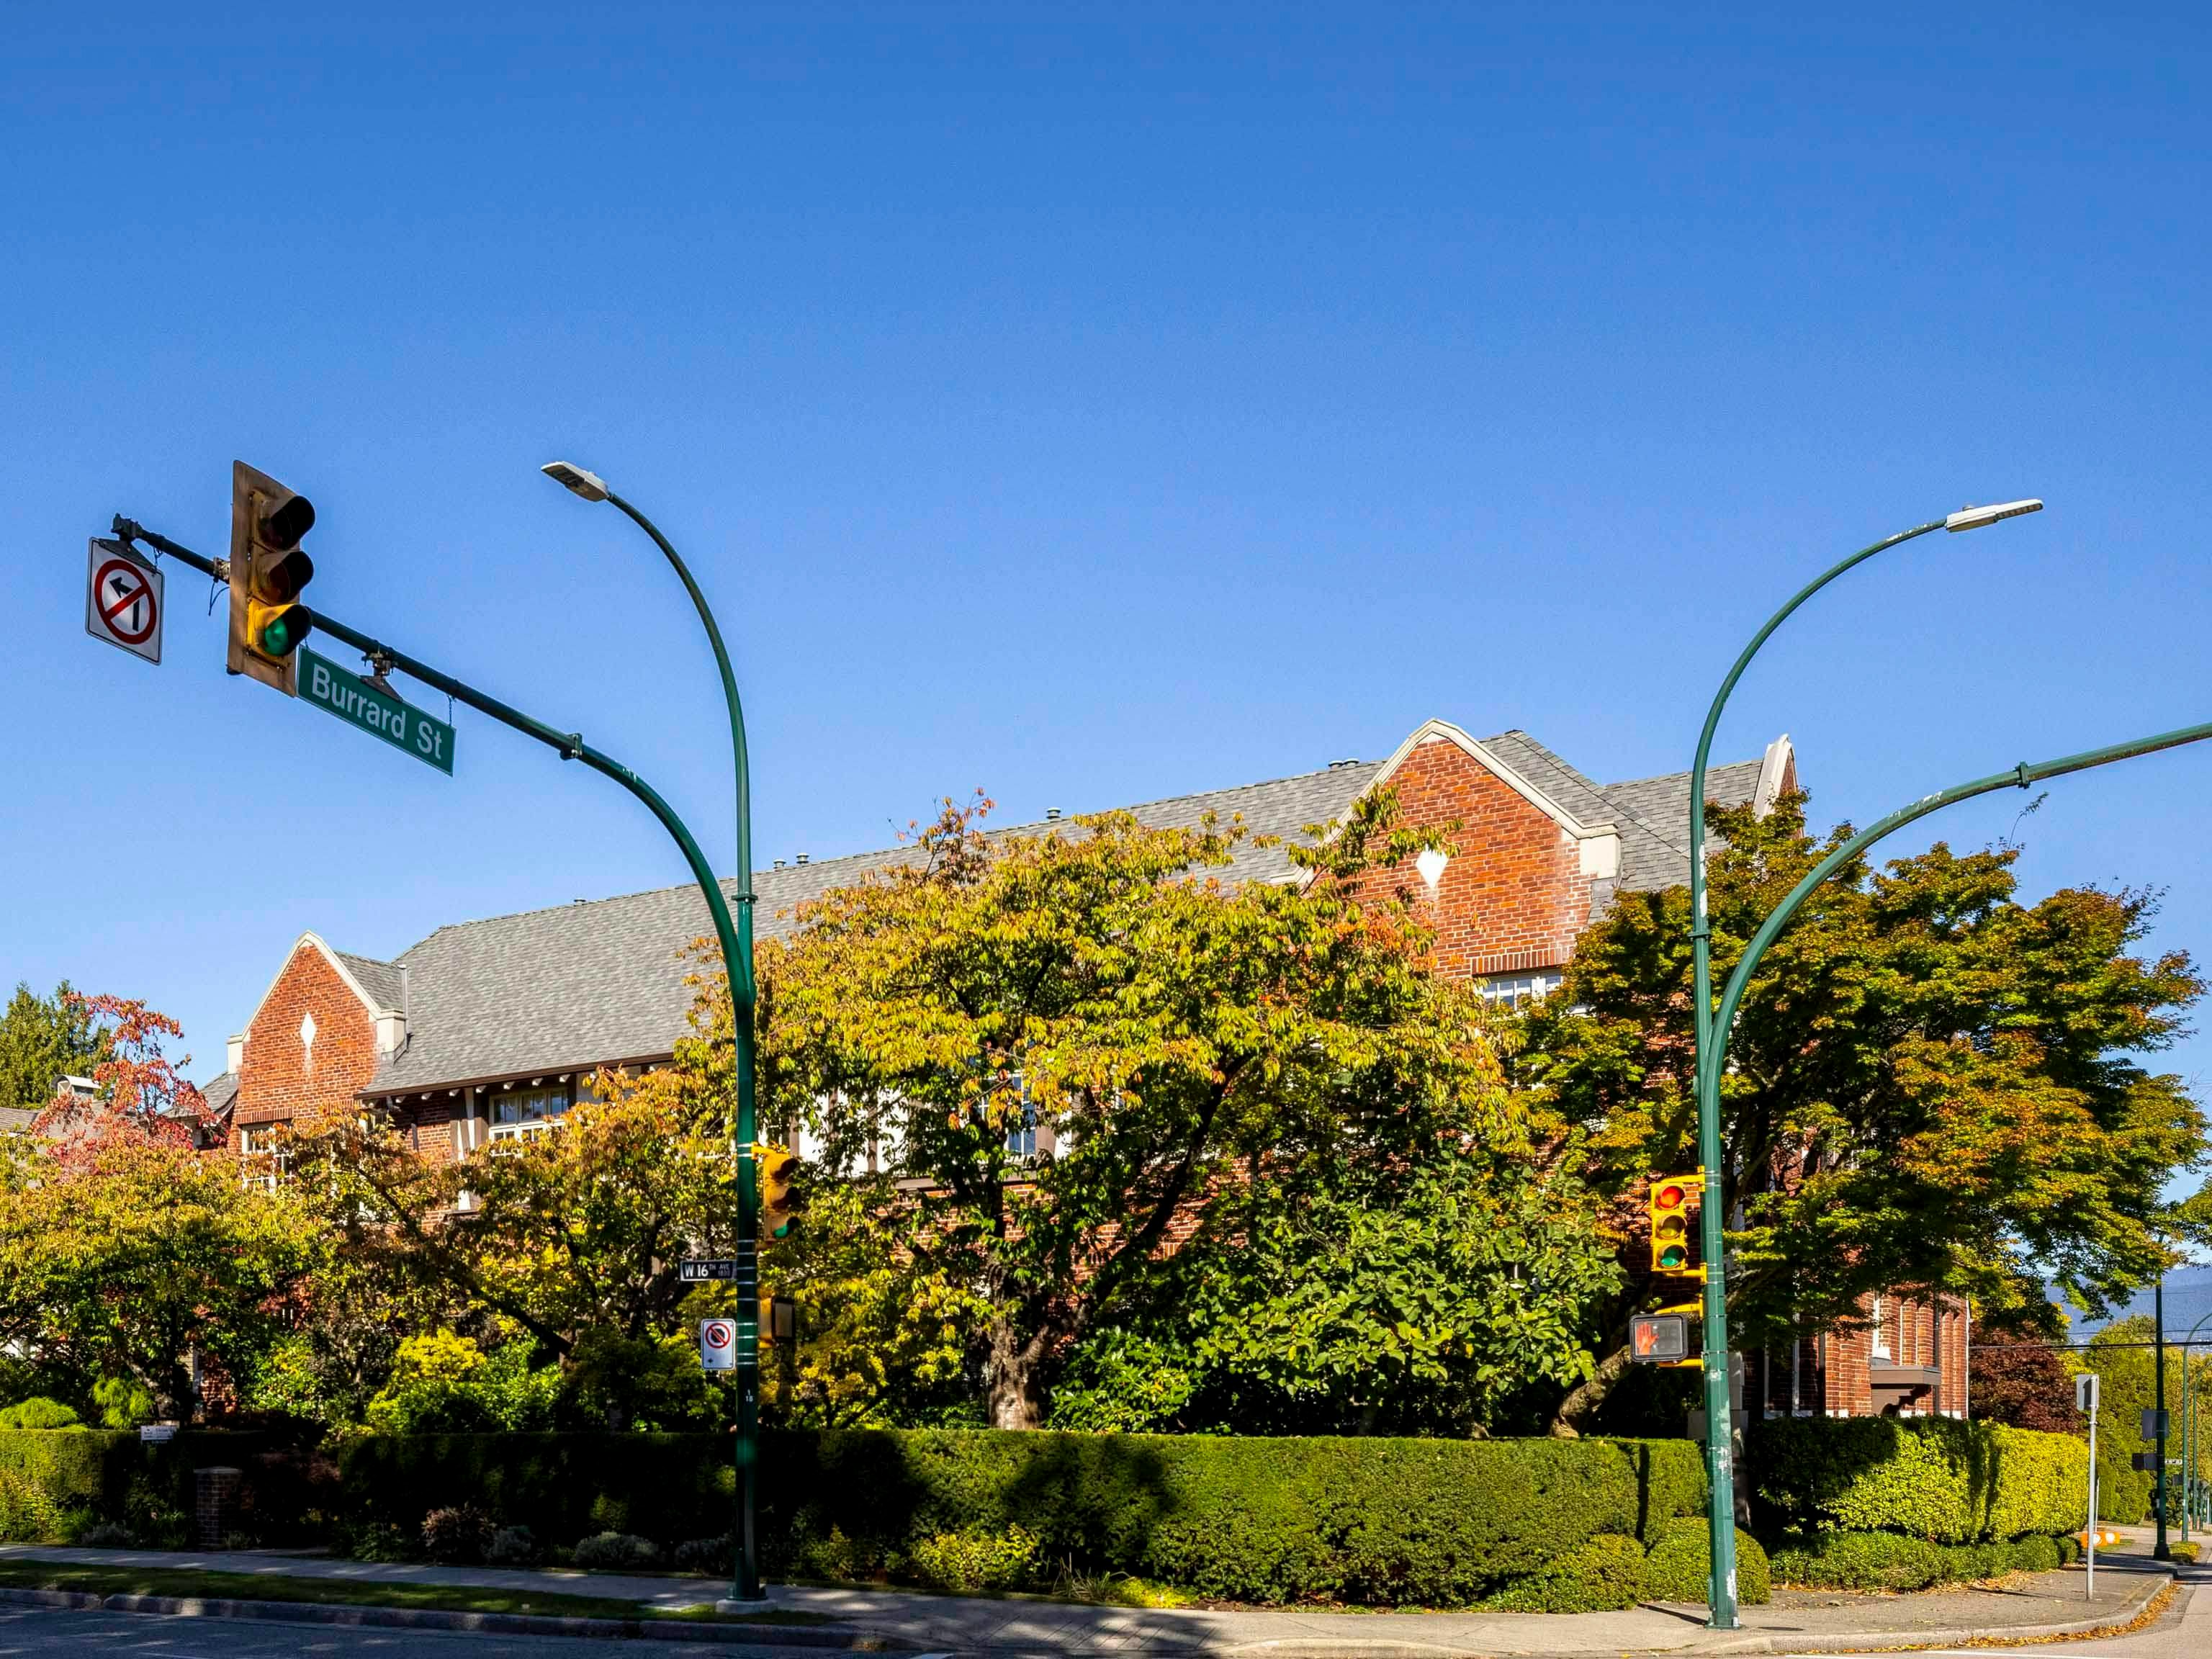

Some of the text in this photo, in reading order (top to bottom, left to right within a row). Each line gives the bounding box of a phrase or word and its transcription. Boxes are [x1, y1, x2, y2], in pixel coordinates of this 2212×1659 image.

[312, 662, 442, 760] Burrard St
[685, 1264, 694, 1277] W
